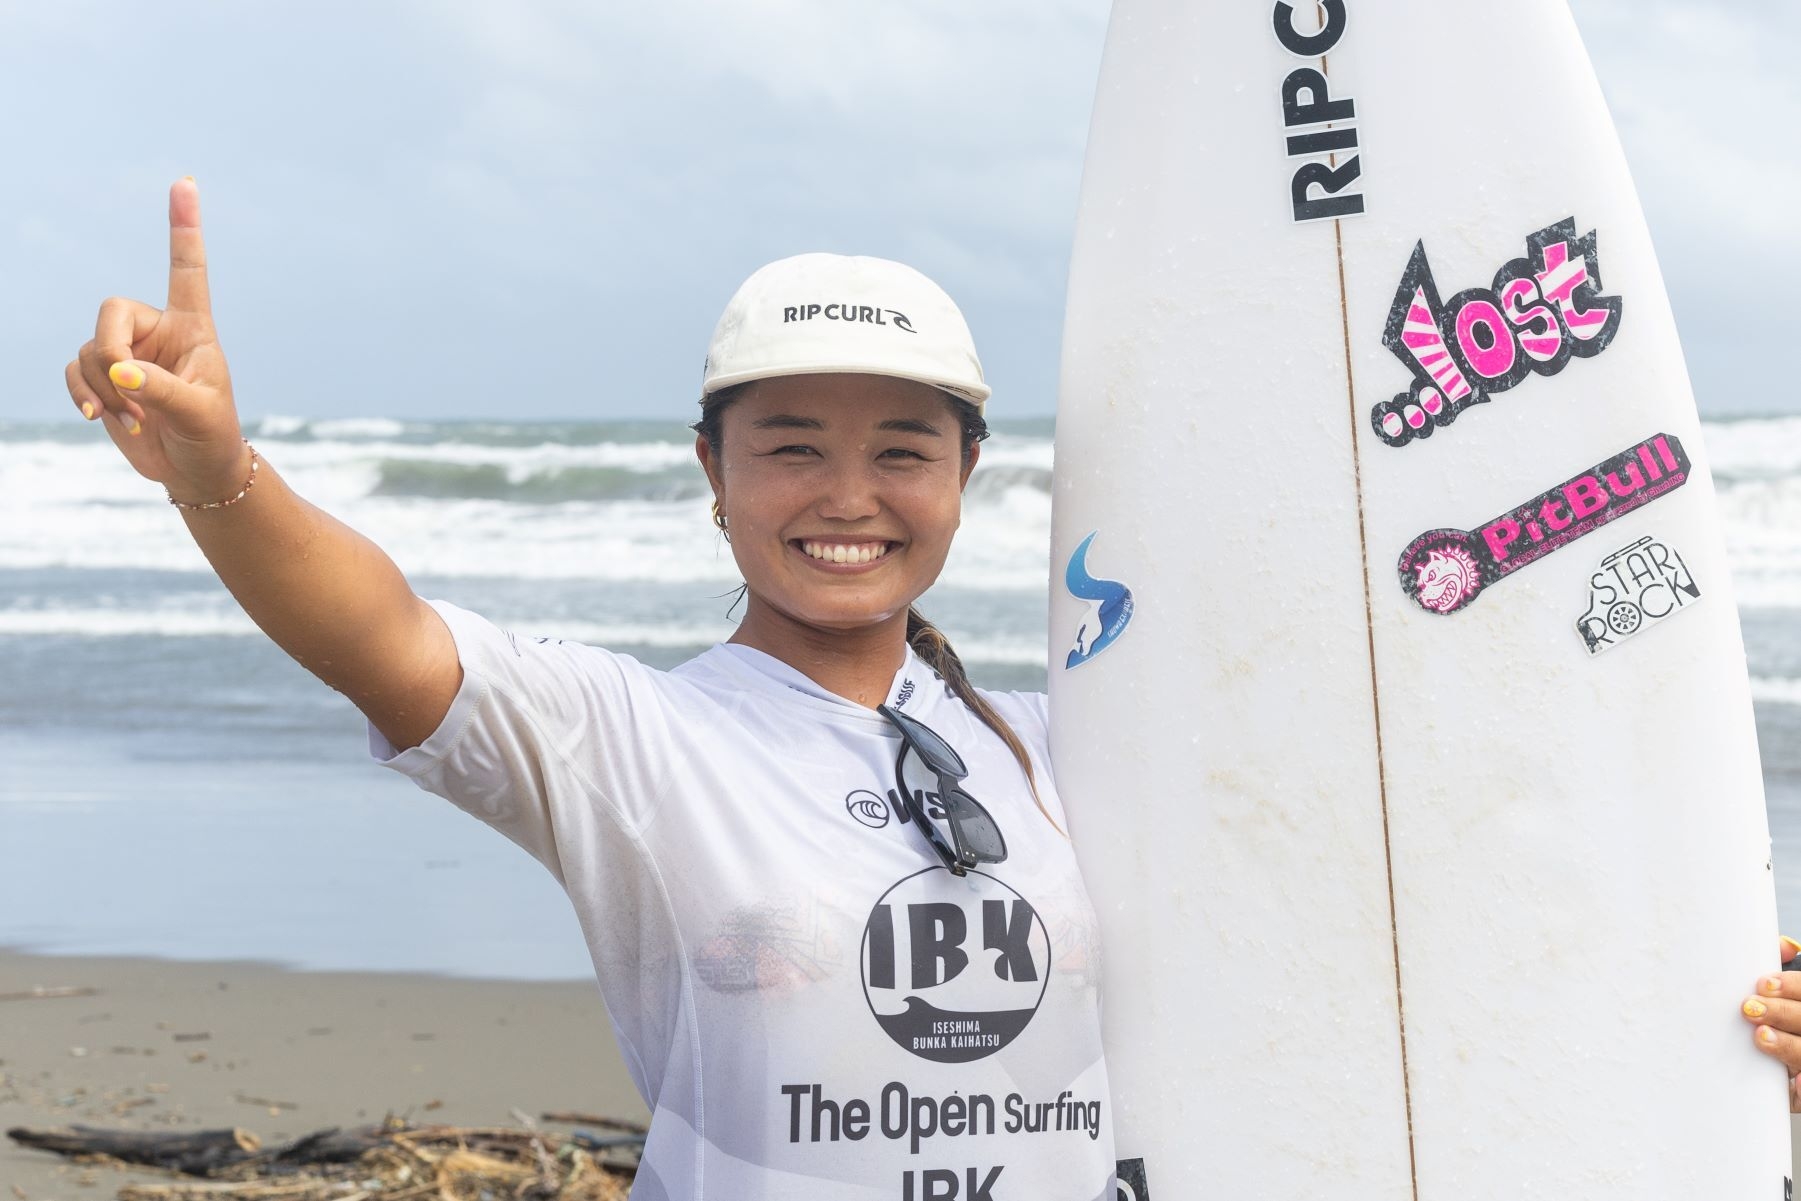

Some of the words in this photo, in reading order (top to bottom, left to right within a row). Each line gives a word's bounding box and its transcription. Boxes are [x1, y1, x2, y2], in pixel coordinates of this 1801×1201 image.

[1481, 436, 1679, 561] PitBull
[1538, 533, 1567, 554] ELITE
[1565, 519, 1595, 540] TEAM
[1591, 543, 1676, 605] STAR
[1583, 570, 1698, 652] ROCK
[868, 899, 1038, 990] IBK
[913, 1036, 947, 1049] BUNKA
[951, 1034, 1000, 1048] KAIHATSU
[933, 1020, 980, 1034] ISESHIMA
[781, 1084, 871, 1143] The
[881, 1081, 995, 1154] Open
[1004, 1091, 1101, 1140] Surfing
